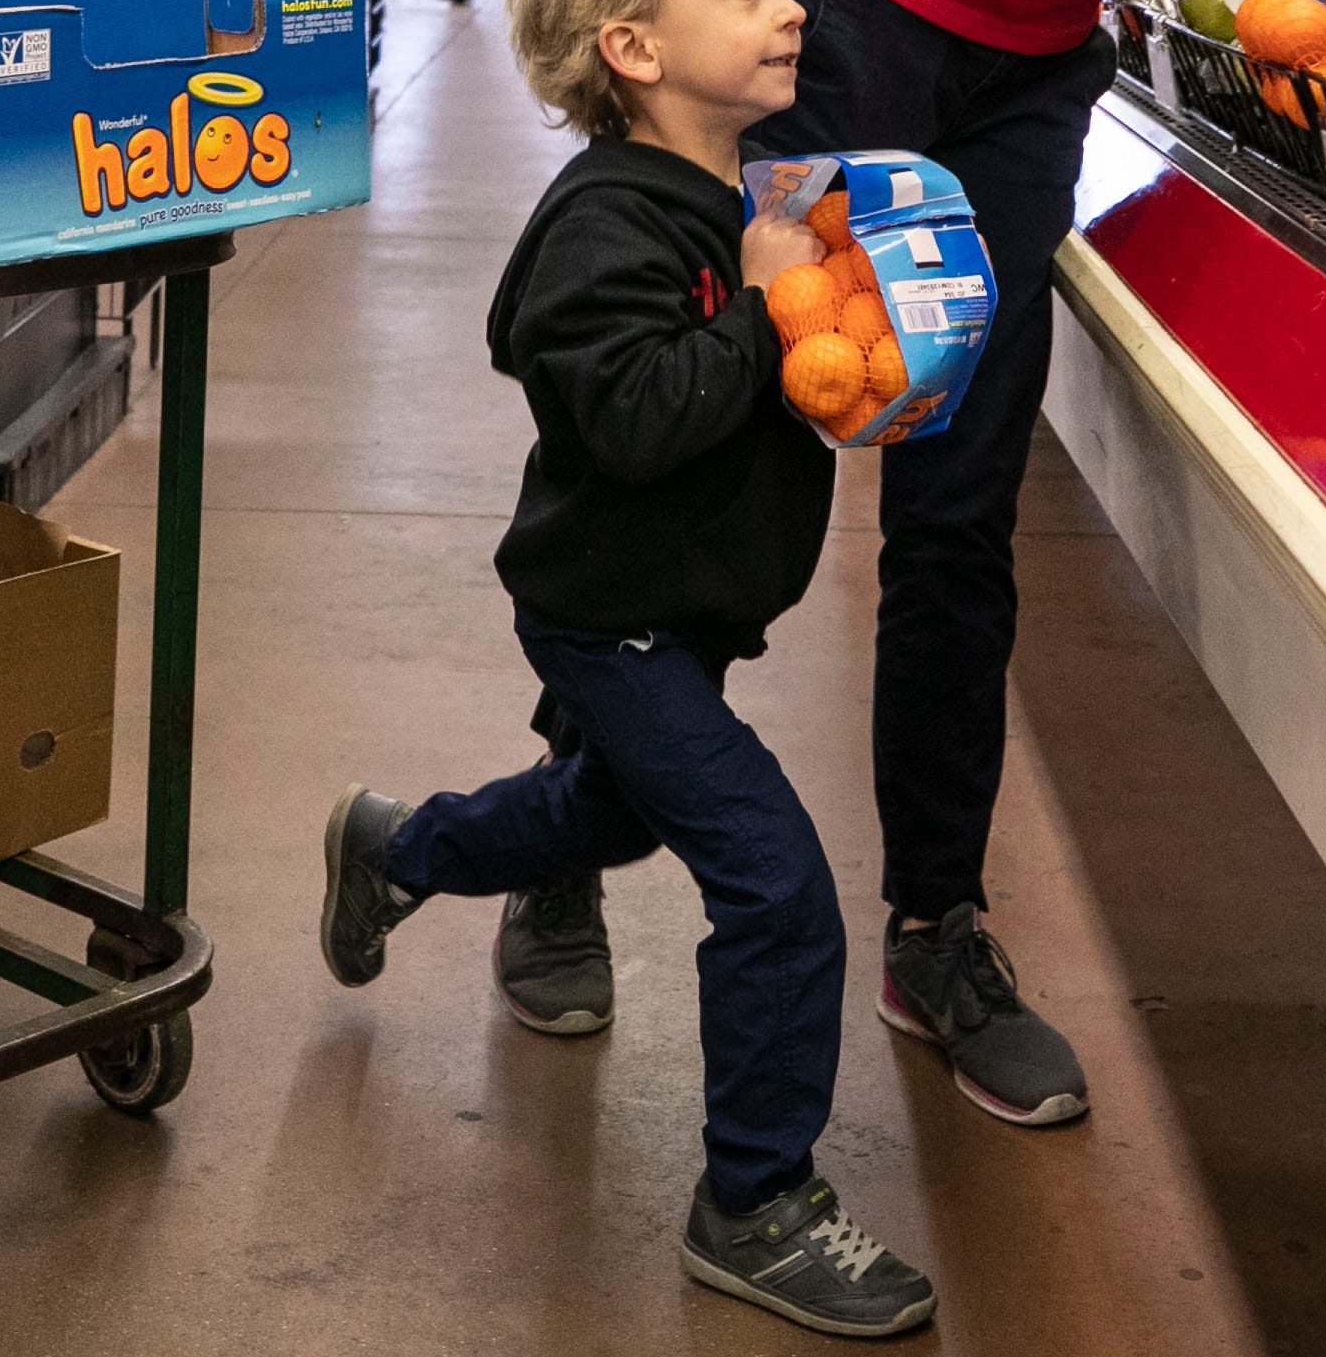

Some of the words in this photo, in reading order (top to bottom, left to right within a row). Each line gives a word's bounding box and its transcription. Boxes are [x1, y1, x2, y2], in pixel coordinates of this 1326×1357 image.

[25, 32, 47, 43] NON
[25, 43, 48, 53] GMO
[0, 61, 47, 75] VERIFIED
[71, 91, 292, 217] halos
[139, 208, 167, 231] pure
[170, 200, 224, 223] goodness
